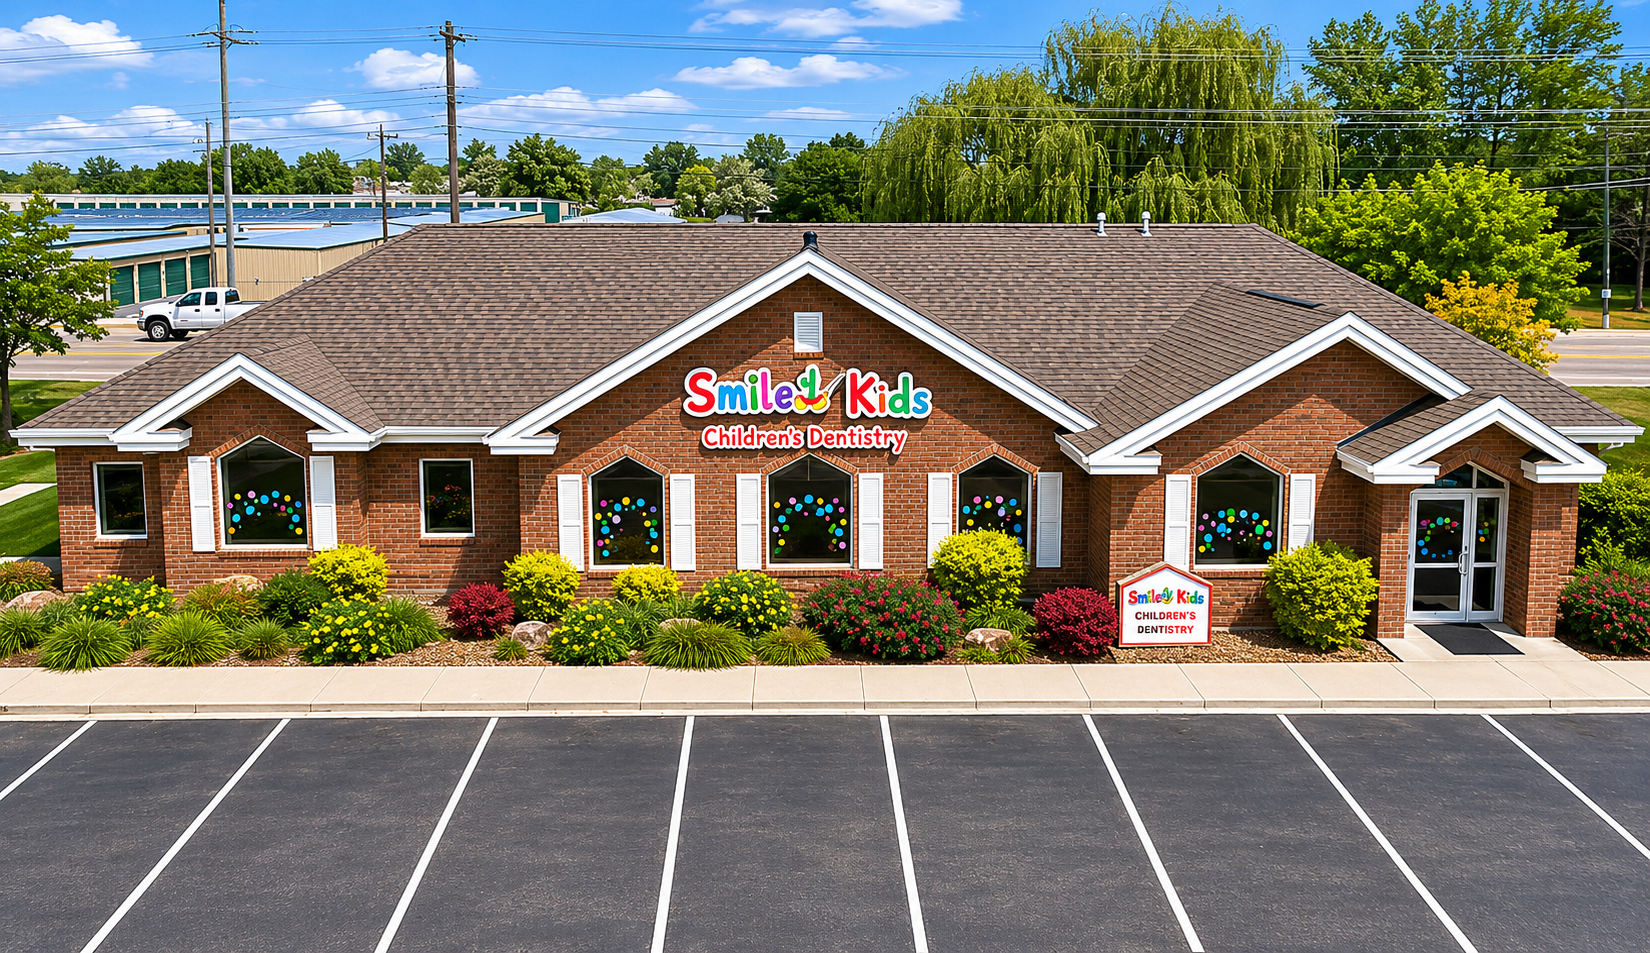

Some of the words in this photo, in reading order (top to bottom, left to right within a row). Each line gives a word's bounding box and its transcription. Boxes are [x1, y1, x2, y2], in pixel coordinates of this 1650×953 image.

[848, 371, 930, 415] Kids
[704, 427, 802, 447] Children's
[809, 429, 906, 453] Dentistry
[1176, 588, 1205, 605] Kids
[1134, 611, 1197, 620] CHILDREN'S
[1137, 625, 1195, 634] DENTISTRY
